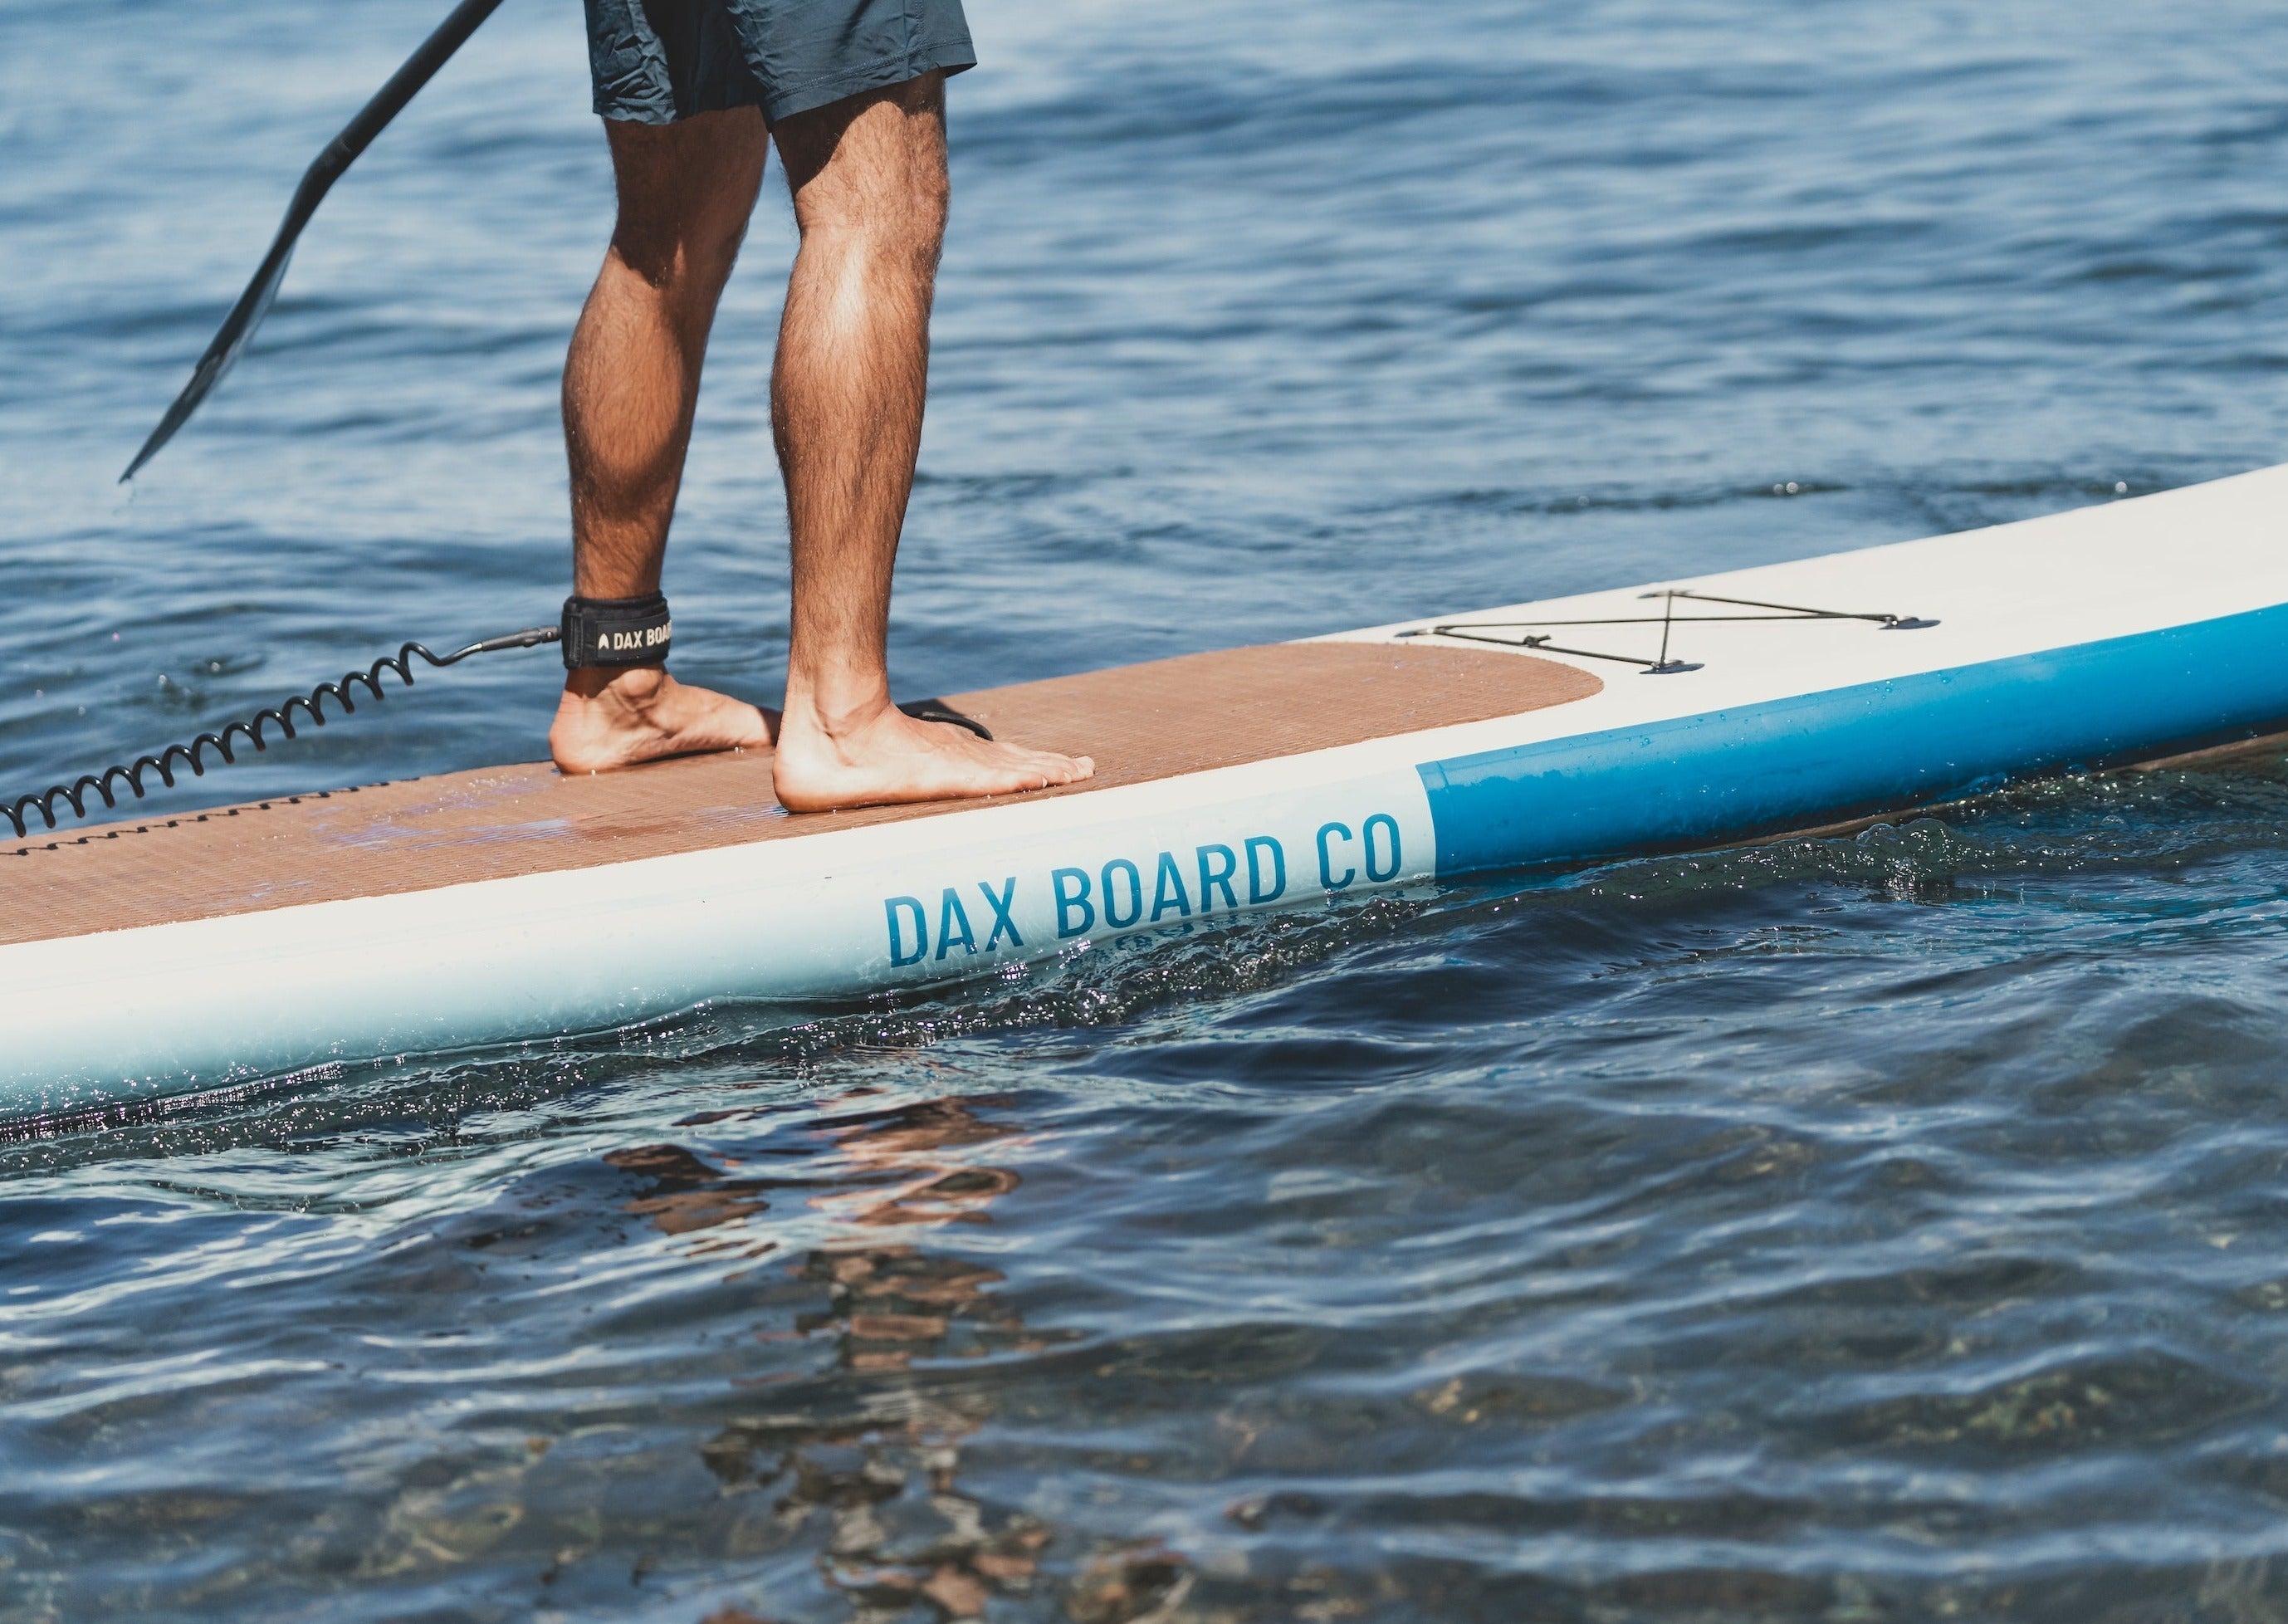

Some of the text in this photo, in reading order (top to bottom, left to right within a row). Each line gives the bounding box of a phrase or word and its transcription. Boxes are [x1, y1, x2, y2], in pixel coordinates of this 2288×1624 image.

[614, 631, 643, 650] DAX
[884, 813, 1401, 967] DAX BOARD CO
